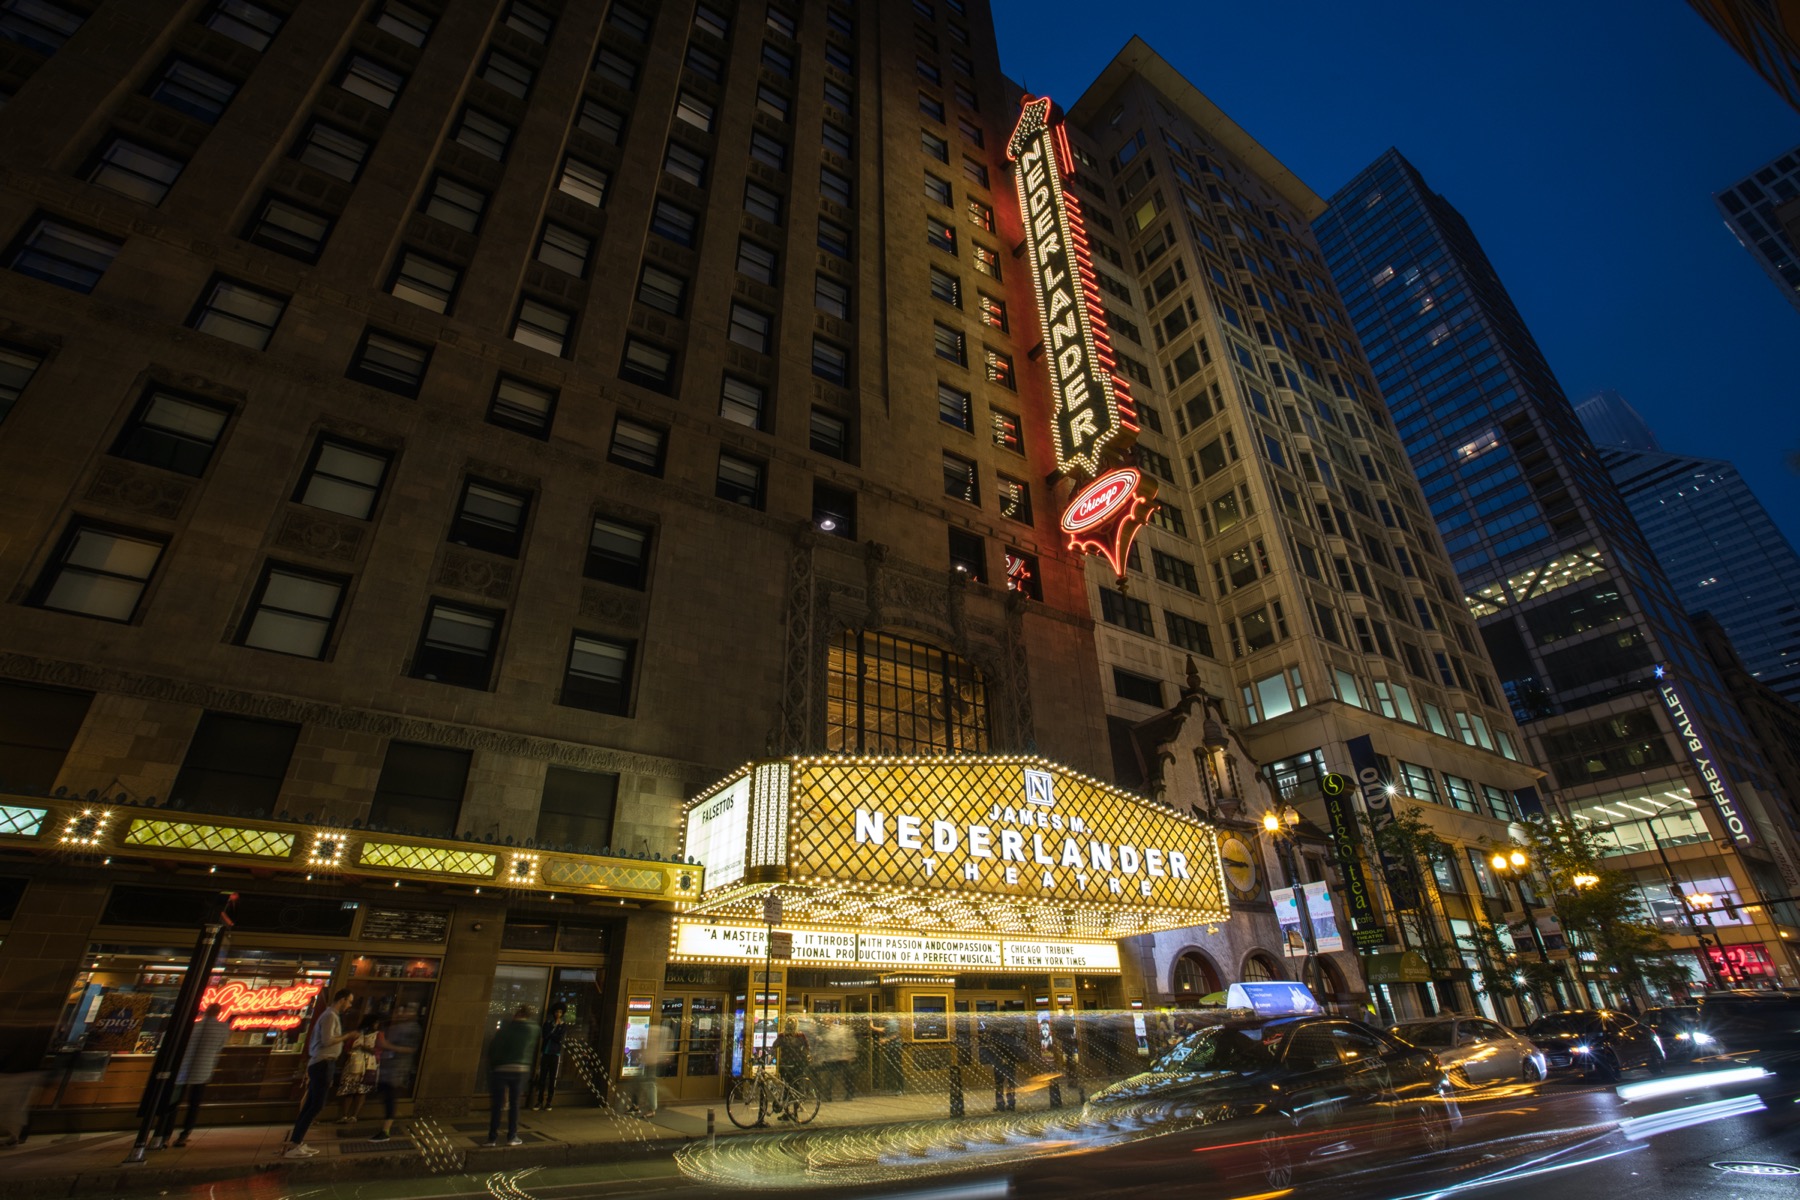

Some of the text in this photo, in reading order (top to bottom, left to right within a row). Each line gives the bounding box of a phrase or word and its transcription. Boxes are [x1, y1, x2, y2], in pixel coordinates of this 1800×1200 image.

[1020, 136, 1099, 448] NEDERLANDER
[1079, 482, 1118, 518] Chicago
[1660, 686, 1750, 844] JOFFREY BALLET
[1359, 767, 1386, 810] OLD
[702, 794, 734, 824] FALSETTOS
[988, 805, 1093, 834] JAMES M.
[854, 808, 1191, 880] NEDERLANDER
[1329, 799, 1368, 910] argo tea
[921, 857, 1153, 897] THEATRE
[723, 930, 798, 945] MASTER.
[805, 934, 814, 944] IT
[818, 935, 855, 947] THROBS
[859, 937, 883, 948] WITH
[885, 938, 922, 950] PASSION
[1351, 928, 1386, 937] RANDOLPH
[1356, 933, 1383, 941] THEATRE
[764, 945, 831, 959] EPTIONAL
[900, 951, 912, 961] OF
[914, 952, 920, 962] A
[923, 952, 958, 963] PERFECT
[1010, 944, 1074, 955] CHICAGO TRIBUNE
[1011, 955, 1087, 966] THE NEW YORK TIMES
[203, 983, 319, 1023] Garrett
[96, 1018, 141, 1032] spicy
[231, 1015, 301, 1030] popcorn shops
